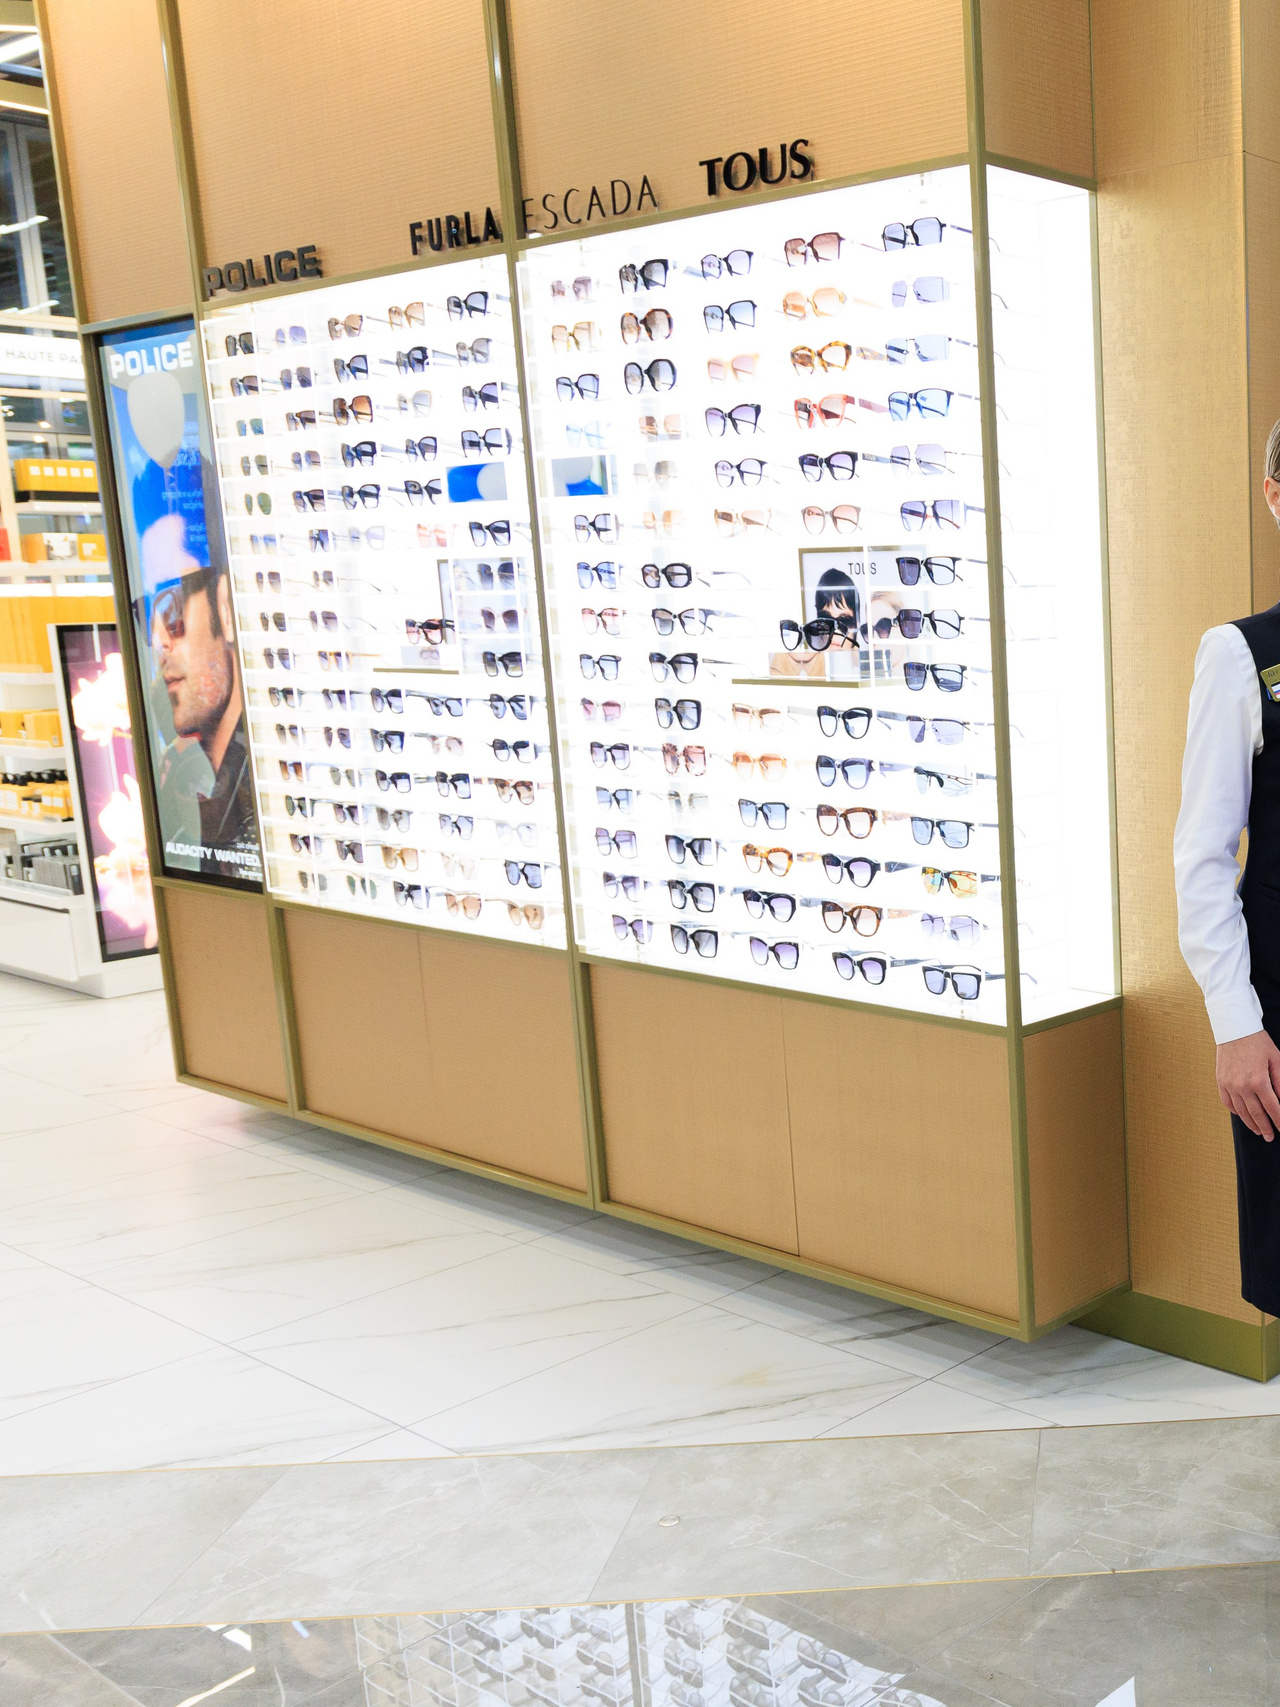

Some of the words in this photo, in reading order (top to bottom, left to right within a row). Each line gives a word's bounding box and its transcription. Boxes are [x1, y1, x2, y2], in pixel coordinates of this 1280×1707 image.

[699, 138, 816, 197] TOUS
[520, 174, 659, 234] ESCADA
[408, 206, 503, 256] FURLA
[202, 245, 321, 298] POLICE
[6, 348, 54, 362] HAUTE
[60, 352, 83, 364] PA
[109, 341, 194, 379] POLICE
[165, 841, 213, 860] AUDACITY
